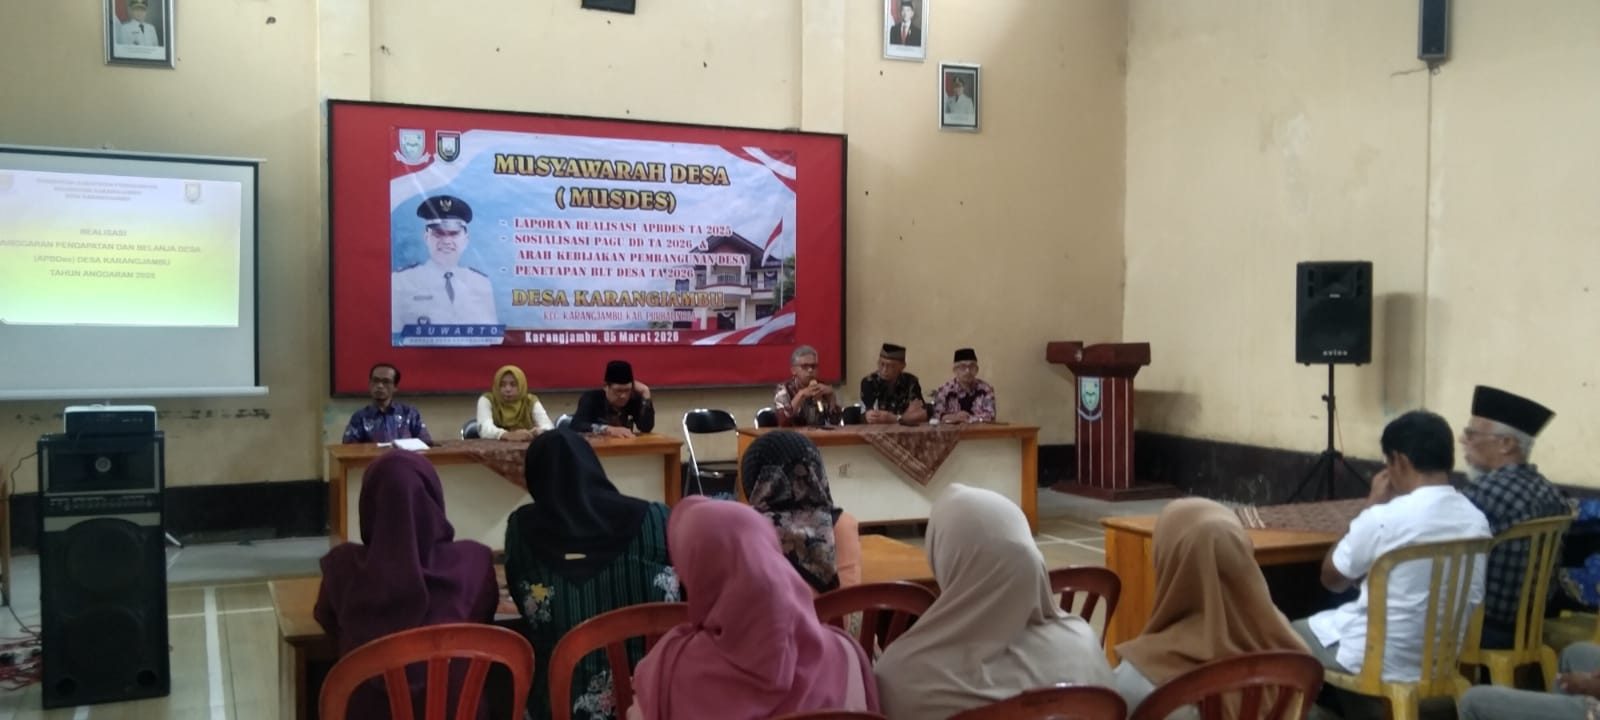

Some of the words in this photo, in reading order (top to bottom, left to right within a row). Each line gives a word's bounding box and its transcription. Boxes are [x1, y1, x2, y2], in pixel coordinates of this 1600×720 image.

[494, 153, 666, 183] MUSYAWARAH
[671, 163, 731, 186] DESA
[515, 218, 572, 230] LAPORAN
[576, 220, 637, 232] REALISASI
[643, 223, 685, 234] APBDES
[690, 225, 703, 235] TA
[706, 225, 733, 236] 2025
[515, 235, 590, 247] SOSIALISASI
[594, 237, 623, 247] PAGU
[628, 238, 645, 248] DD
[648, 238, 662, 248] TA
[666, 239, 693, 249] 2026
[518, 250, 552, 261] ARAH
[556, 250, 626, 262] KEBIJAKAN
[629, 253, 714, 265] PEMBANGUNAN
[716, 255, 747, 266] DESA
[514, 265, 587, 277] PENETAPAN
[590, 267, 612, 277] BLT
[616, 267, 646, 278] DESA
[667, 269, 695, 279] 2026
[511, 288, 570, 307] DESA
[415, 326, 499, 336] SUWARTO
[603, 331, 617, 343] 05
[619, 331, 651, 343] Maret
[654, 331, 679, 343] 2026
